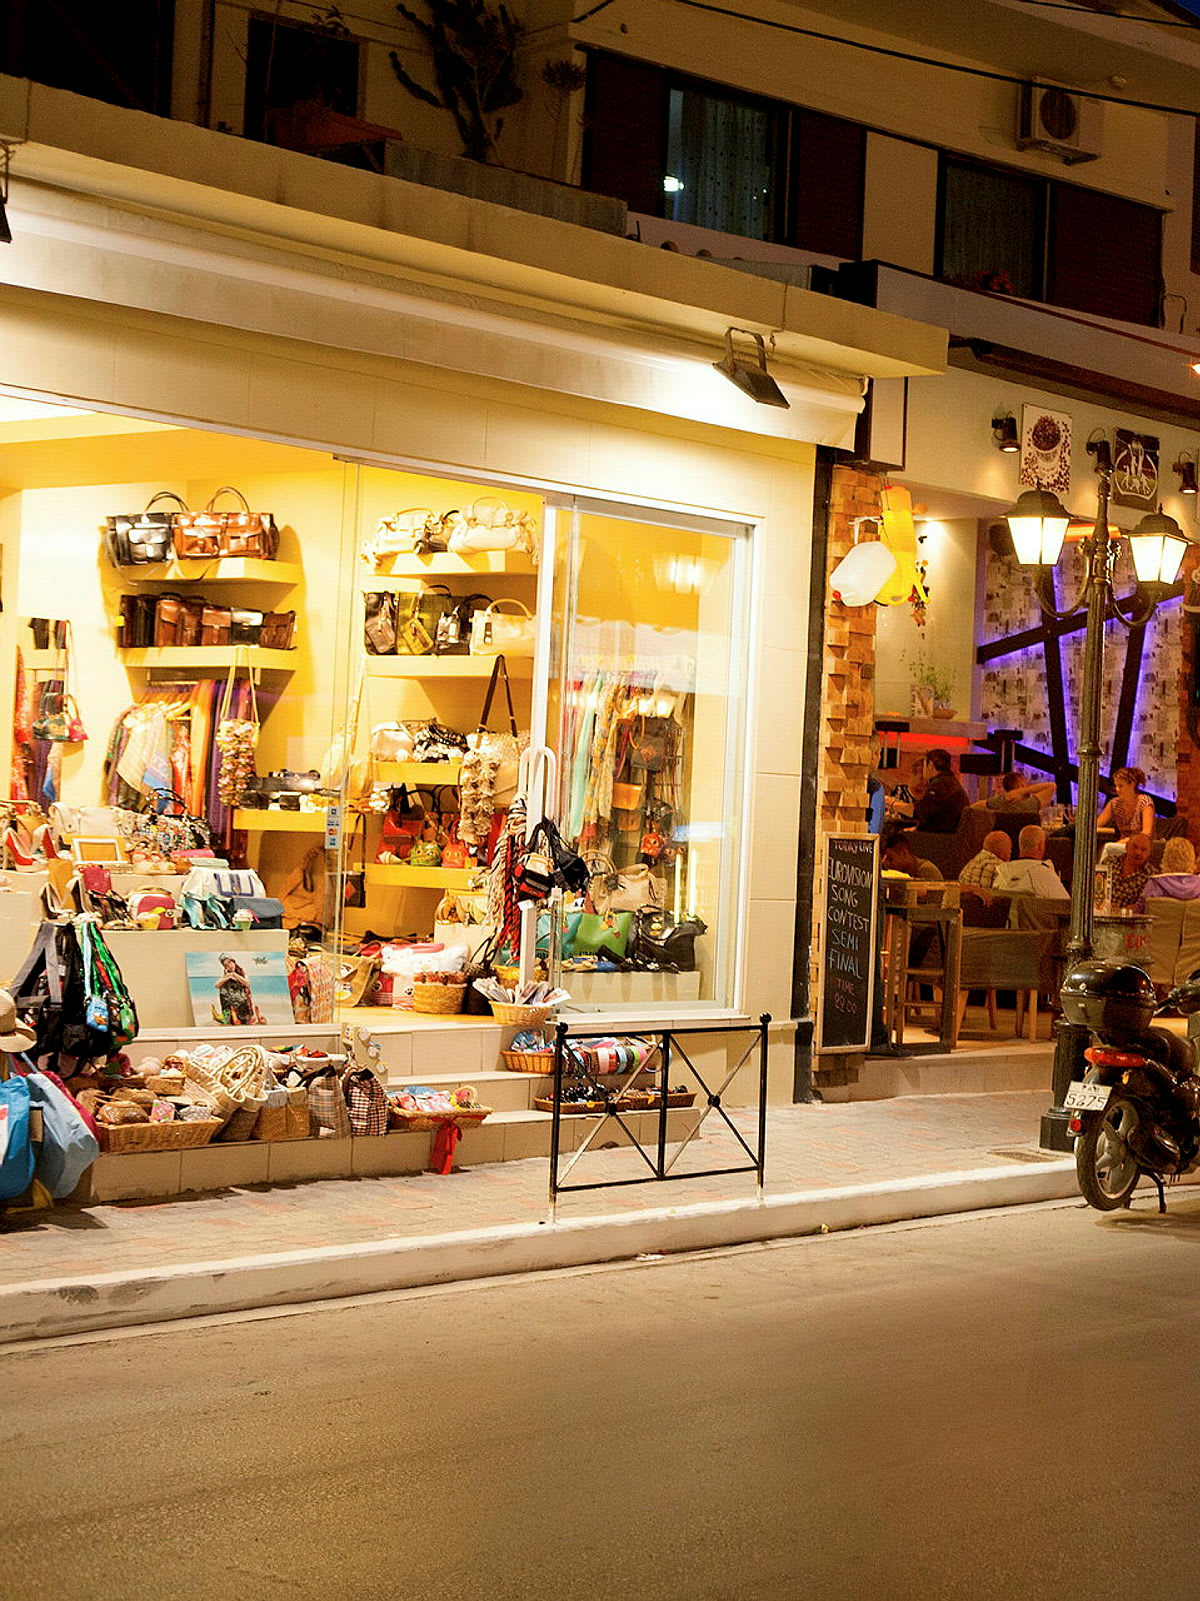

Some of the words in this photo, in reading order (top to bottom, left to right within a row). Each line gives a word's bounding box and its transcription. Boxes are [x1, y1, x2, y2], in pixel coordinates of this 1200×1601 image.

[832, 884, 858, 907] SONG
[828, 906, 869, 932] CONTEST
[832, 929, 858, 950] SEMI
[829, 948, 863, 979] FINAL
[1067, 1093, 1107, 1109] 5275
